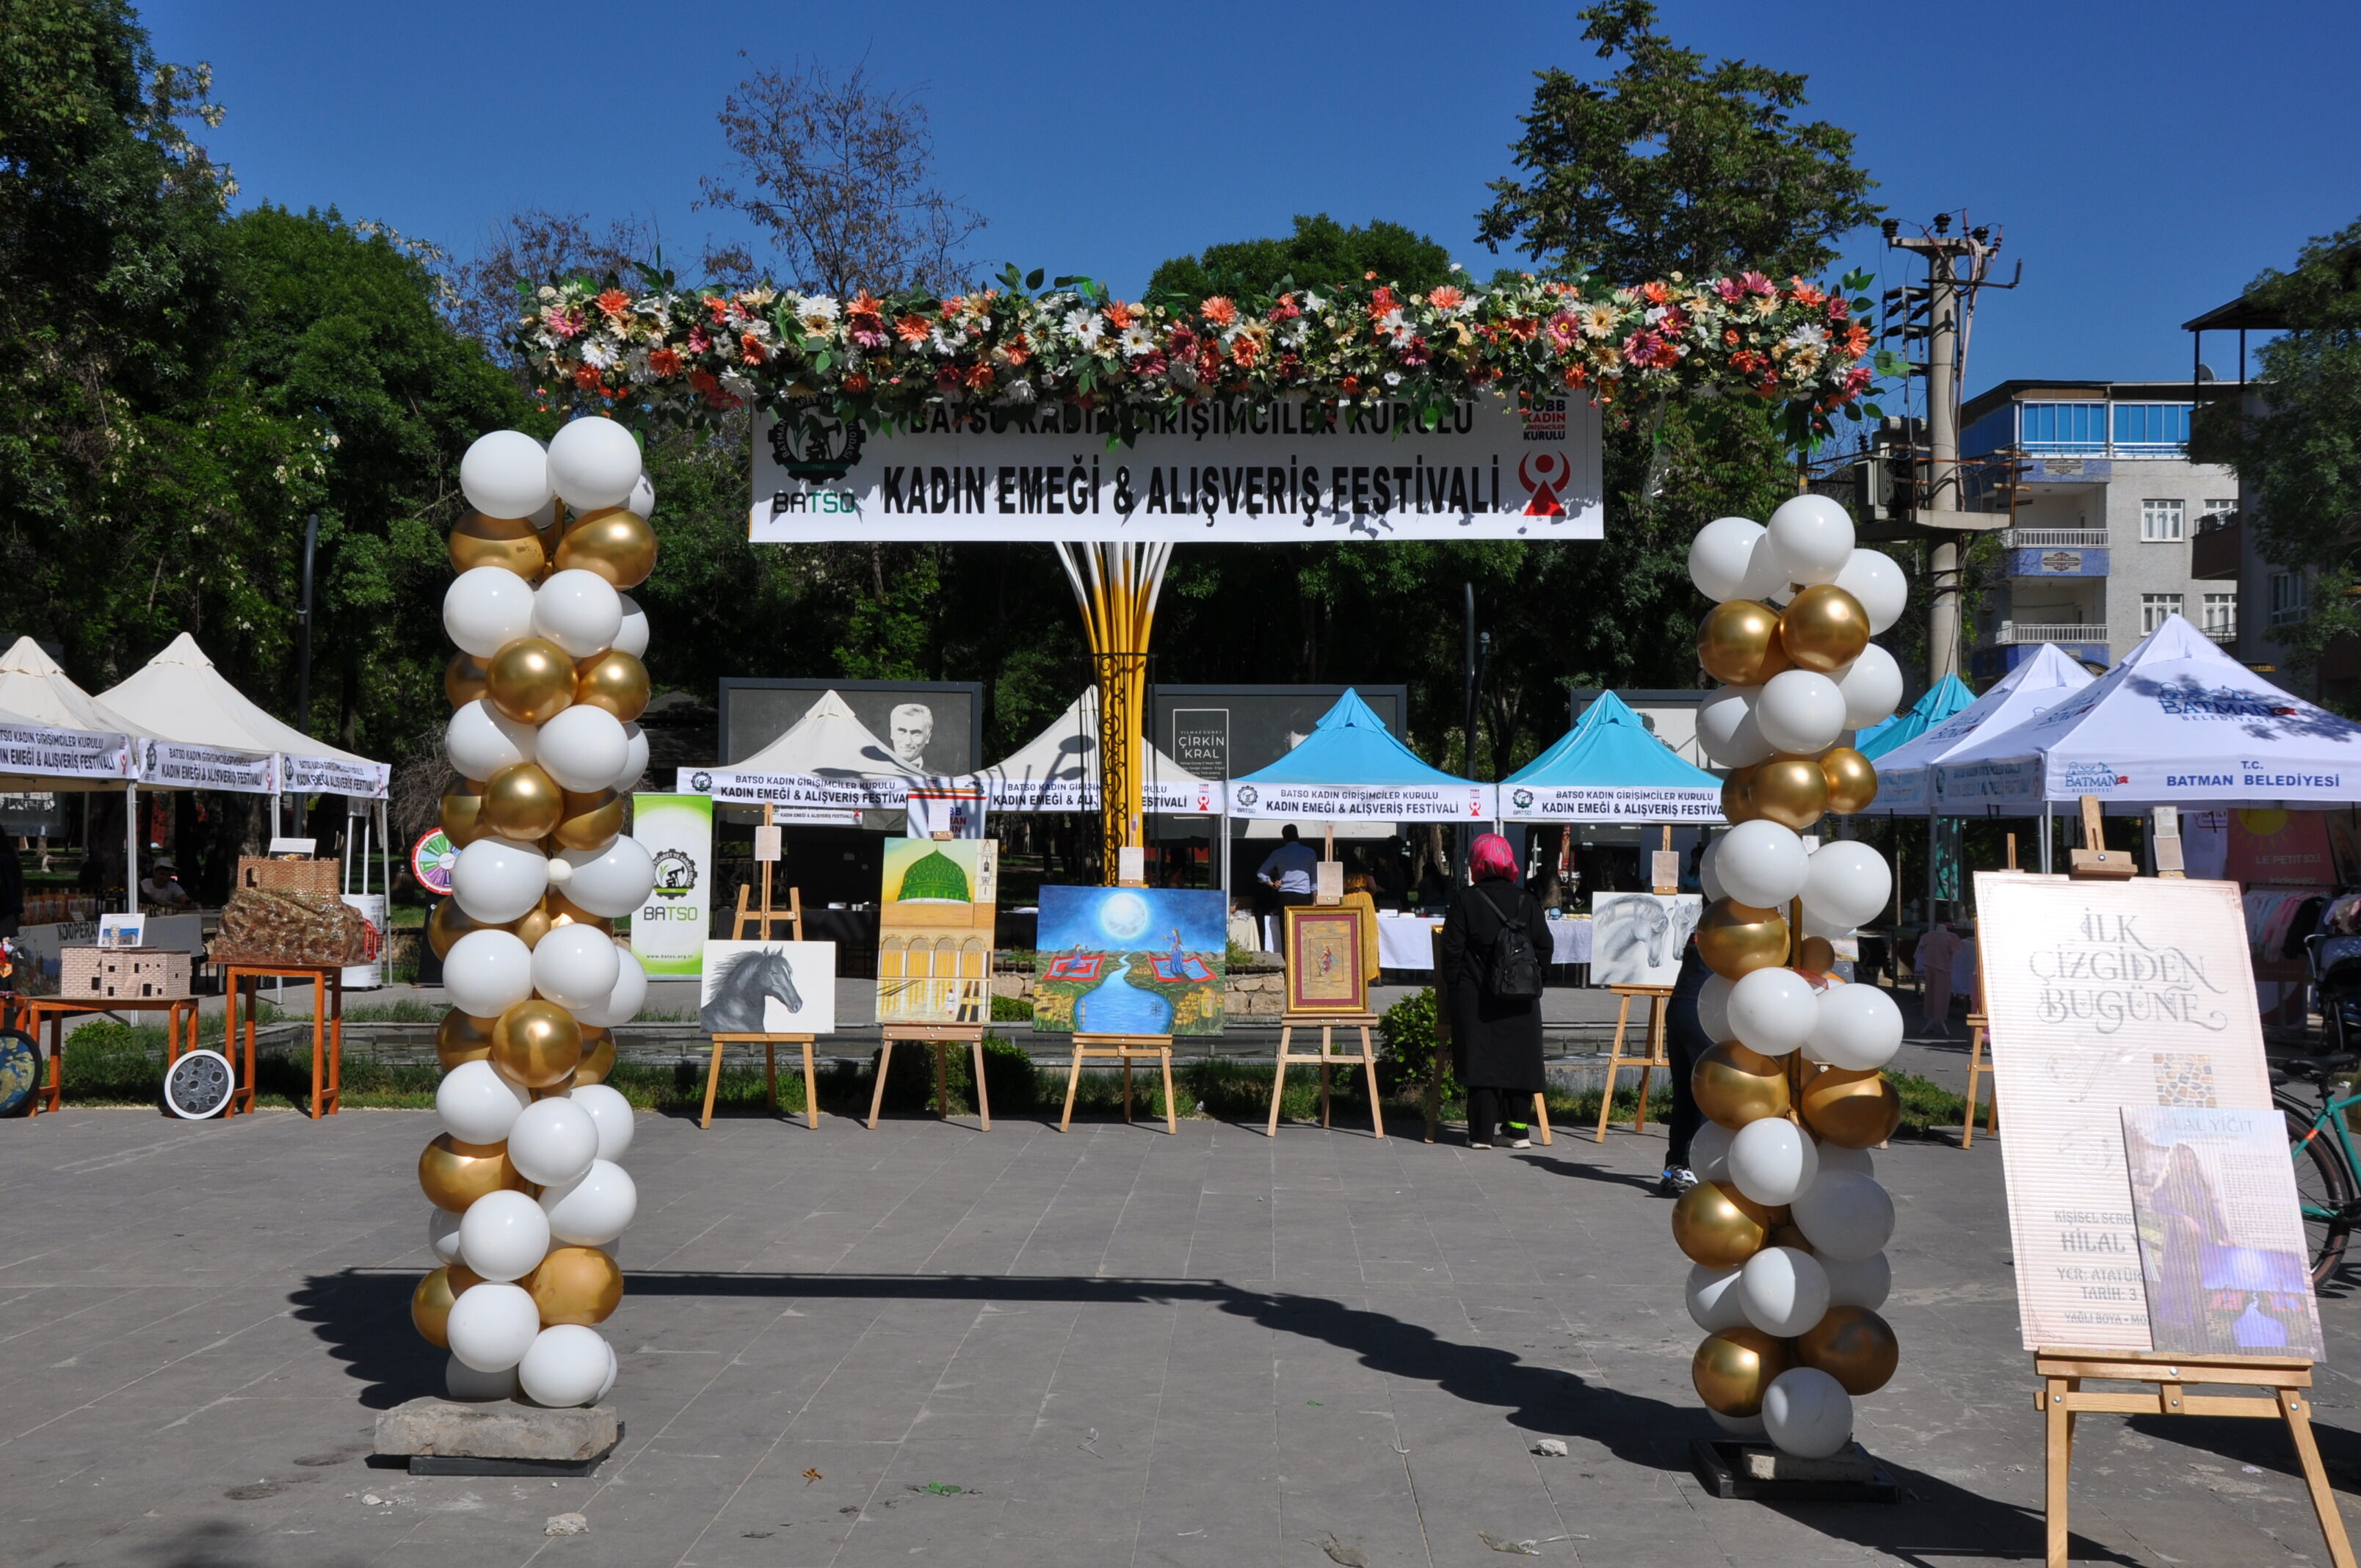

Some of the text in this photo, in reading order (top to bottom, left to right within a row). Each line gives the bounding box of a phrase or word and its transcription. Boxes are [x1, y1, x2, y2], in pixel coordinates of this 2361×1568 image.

[1528, 399, 1566, 412] OBB
[1523, 430, 1566, 441] KURULU
[884, 454, 1499, 528] KADIN EMEĞİ & ALIŞVERİŞ FESTİVALİ
[773, 492, 855, 514] BATSO
[2158, 700, 2274, 717] BATMAN
[2182, 714, 2271, 725] BELEDİYESİ
[0, 730, 12, 741] TSO
[14, 730, 35, 744] KADIN
[78, 736, 104, 749] KURULU
[1178, 734, 1225, 749] ÇİRKİN
[11, 747, 35, 766] EMEĞİ
[37, 754, 42, 766] &
[1184, 749, 1219, 758] KRAL
[161, 763, 181, 779] KADIN
[2241, 761, 2263, 770] T.C.
[736, 775, 896, 790] BATSO KADIN GİRİŞİMCİLER KURULU
[1007, 783, 1035, 791] BATSO
[1039, 783, 1066, 791] KADIN
[2065, 775, 2118, 788] BATMAN
[2166, 773, 2340, 788] BATMAN BELEDİYESİ
[721, 786, 907, 806] KADIN EMEĞİ & ALIŞVERİŞ FESTİVA
[993, 794, 1026, 805] KADIN
[1029, 792, 1062, 806] EMEĞİ
[1066, 794, 1073, 805] &
[1142, 794, 1187, 807] ESTİVALİ
[1281, 789, 1439, 802] BATSO KADIN GİRİŞİMCİLER KURULU
[1556, 789, 1713, 802] BATSO KADIN GİRİŞİMCİLER KURULU
[949, 807, 962, 816] BB
[1266, 800, 1459, 816] KADIN EMEĞİ & ALIŞVERİŞ FESTİVALİ
[1542, 801, 1724, 817] KADIN EMEĞİ & ALIŞVERİŞ FESTİVA
[643, 906, 697, 921] BATSO
[56, 921, 100, 942] KOOPERAT
[2081, 907, 2157, 951] İLK
[2029, 944, 2229, 994] ÇİZGİDEN
[2037, 984, 2227, 1034] BUGÜNE
[2054, 1209, 2132, 1225] KİŞİSEL SERG
[2061, 1228, 2126, 1252] HİLAL
[2057, 1266, 2142, 1282] YER: ATATÜR
[2081, 1285, 2137, 1301] TARİH: 3
[2064, 1310, 2093, 1324] YAĞLI
[2096, 1313, 2122, 1324] BOYA
